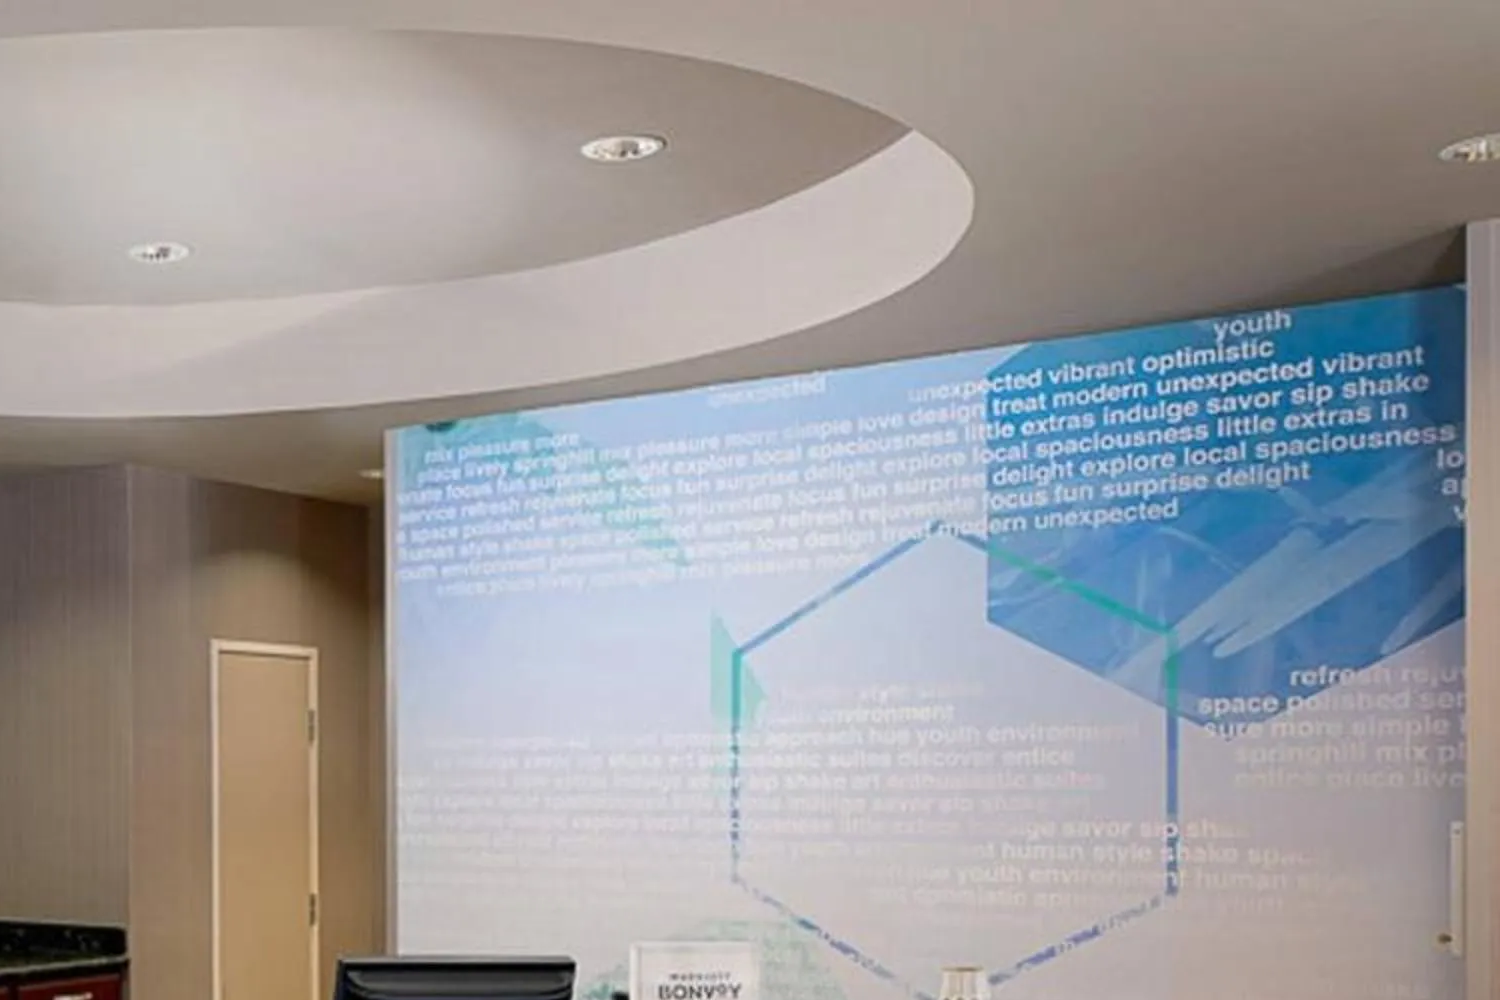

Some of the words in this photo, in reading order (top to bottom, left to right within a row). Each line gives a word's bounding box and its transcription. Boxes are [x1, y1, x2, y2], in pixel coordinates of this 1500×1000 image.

[1213, 310, 1292, 341] youth
[857, 413, 903, 432] love
[908, 401, 986, 426] design
[993, 392, 1047, 416] treat
[1053, 382, 1148, 408] modern
[1156, 356, 1314, 396] unexpected
[1321, 343, 1425, 375] vibrant
[908, 367, 1042, 403] unexpected
[1049, 356, 1136, 385] vibrant
[1142, 337, 1275, 376] optimistic
[807, 428, 958, 463] spaciousness
[1021, 412, 1096, 435] extras
[1103, 399, 1199, 427] indulge
[1206, 390, 1283, 414] savor
[1291, 381, 1333, 407] sip
[1341, 370, 1430, 399] shake
[881, 450, 966, 475] explore
[972, 438, 1029, 464] local
[1035, 423, 1210, 461] spaciousness
[1217, 413, 1276, 438] little
[1283, 406, 1372, 431] extras
[1380, 398, 1409, 421] in
[993, 459, 1074, 486] delight
[1080, 451, 1176, 479] explore
[1183, 440, 1246, 467] local
[1255, 423, 1456, 463] spaciousness
[981, 490, 1048, 512] focus
[1054, 484, 1093, 505] fun
[1101, 472, 1210, 501] surprise
[1216, 458, 1312, 488] delight
[1034, 496, 1179, 529] unexpected
[1199, 693, 1280, 717] space
[1287, 688, 1410, 713] polished
[1350, 713, 1451, 745] simple
[1376, 741, 1430, 764] mix
[658, 983, 742, 1000] BONVOY
